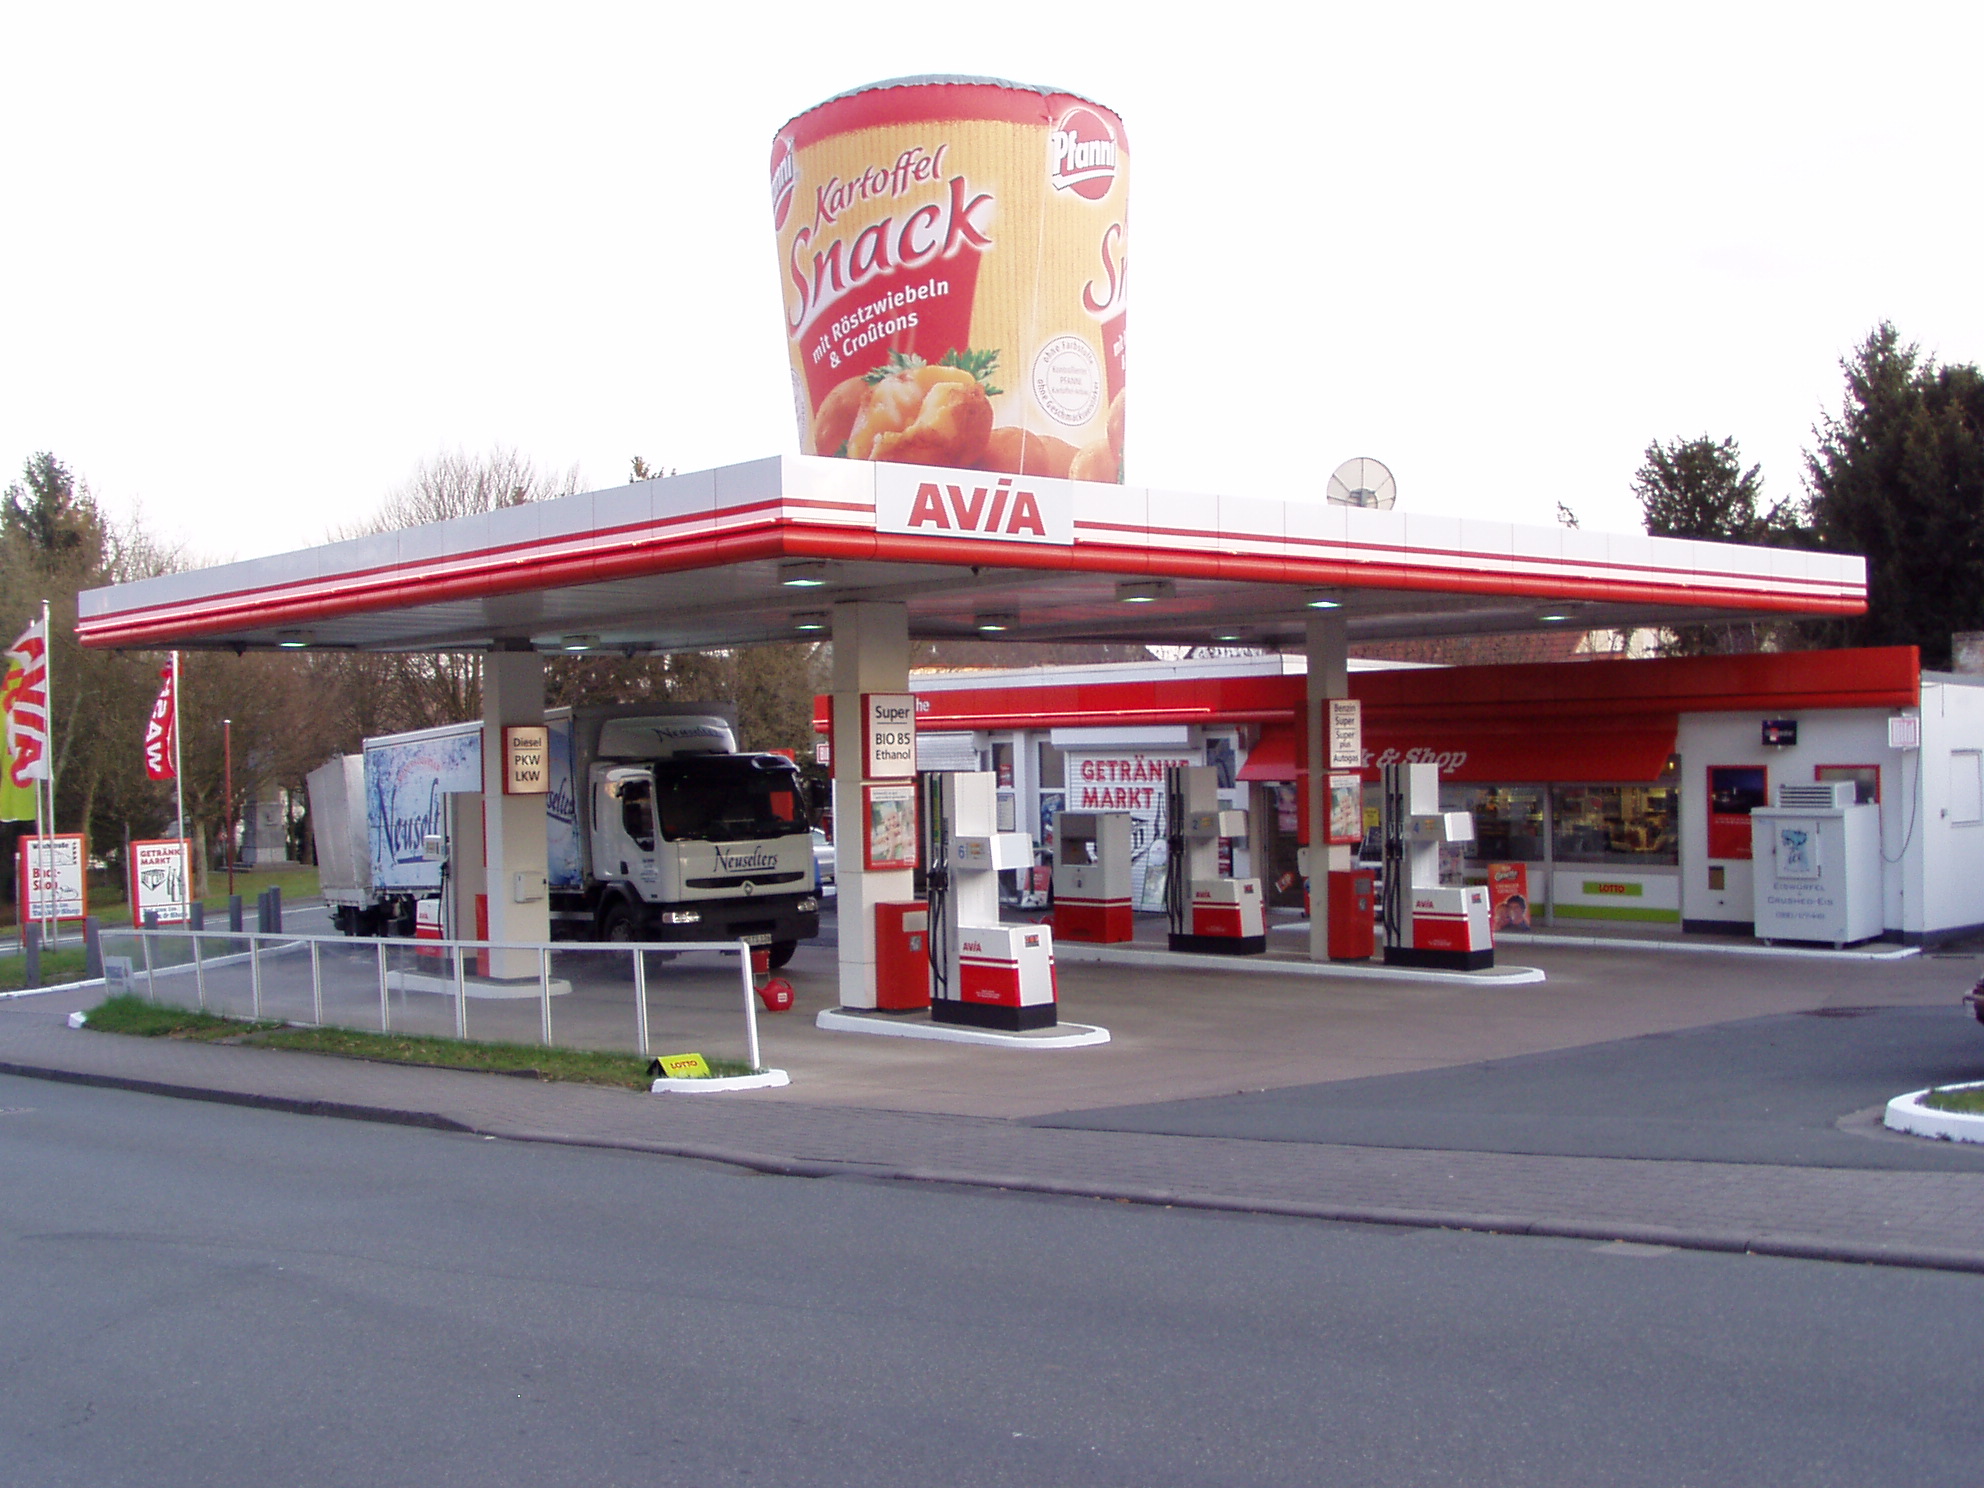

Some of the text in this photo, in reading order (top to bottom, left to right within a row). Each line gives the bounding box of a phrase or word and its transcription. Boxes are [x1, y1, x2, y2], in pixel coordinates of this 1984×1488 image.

[1052, 130, 1116, 173] Pfanni
[813, 144, 948, 236] Kartoffel
[789, 175, 995, 335] Snack
[812, 279, 950, 364] mit Röstzwiebeln
[829, 311, 919, 369] & Croûtons
[907, 478, 1046, 537] AVIA
[1334, 703, 1357, 712] Benzin
[875, 705, 911, 722] Super
[1335, 716, 1355, 726] Super
[875, 732, 911, 745] BIO 85
[1335, 731, 1355, 741] Super
[513, 738, 542, 748] Diesel
[1340, 741, 1352, 749] plus
[514, 755, 541, 766] PKW
[875, 749, 911, 761] Ethanol
[1333, 754, 1359, 764] Autogas
[1376, 748, 1401, 768] &
[1401, 748, 1468, 774] Shop
[515, 771, 541, 782] LKW
[1082, 787, 1155, 809] MARKT
[141, 847, 185, 857] GETRÄNK
[958, 844, 966, 859] 6
[141, 857, 171, 866] MARKT
[713, 846, 779, 873] Neuselters
[1599, 883, 1625, 893] LOTTO
[1415, 899, 1434, 908] AVIA
[963, 941, 982, 952] AVIA
[670, 1060, 698, 1070] LOTTO
